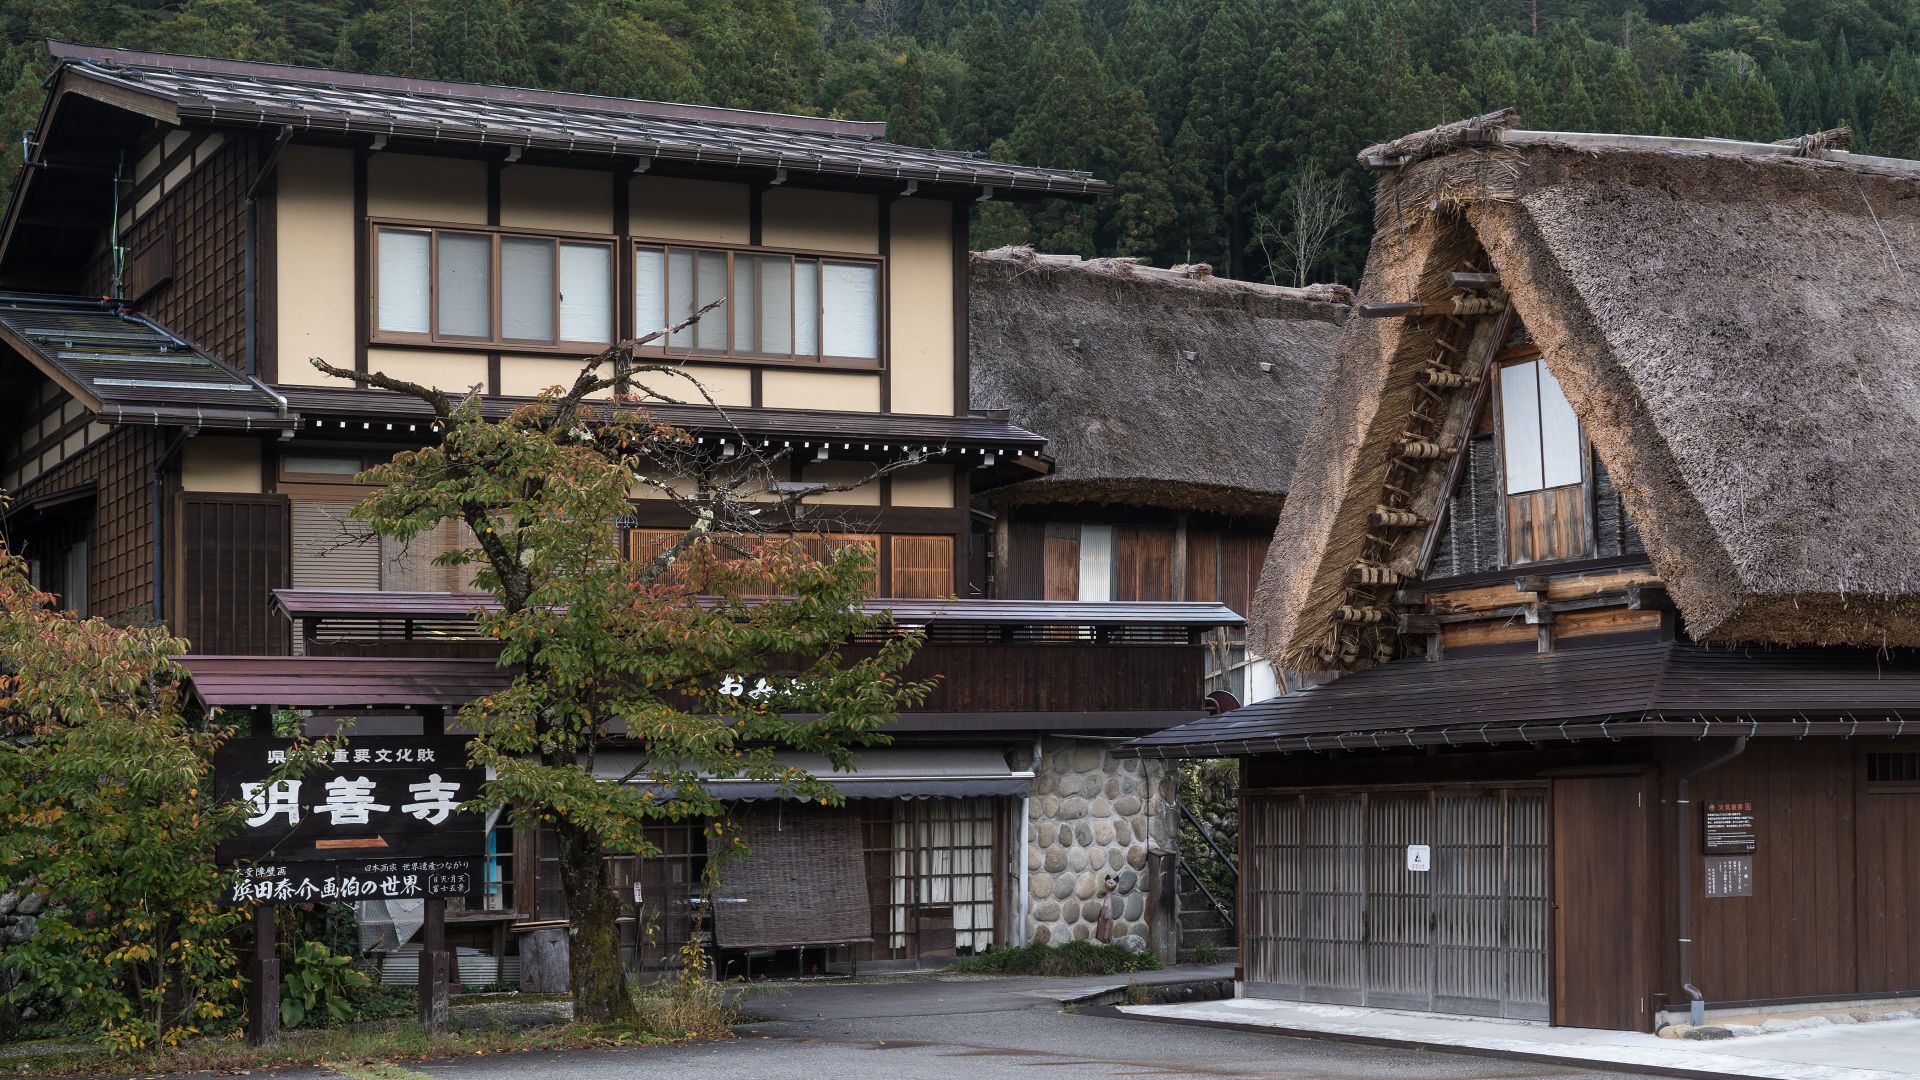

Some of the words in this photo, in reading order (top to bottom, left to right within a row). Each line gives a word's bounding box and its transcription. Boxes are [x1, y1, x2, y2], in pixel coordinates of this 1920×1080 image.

[267, 748, 436, 764] 県重要文化財
[240, 773, 468, 828] 明善寺
[401, 861, 470, 871] 世界遺産つながり
[232, 873, 423, 903] 浜田泰介画伯の世界
